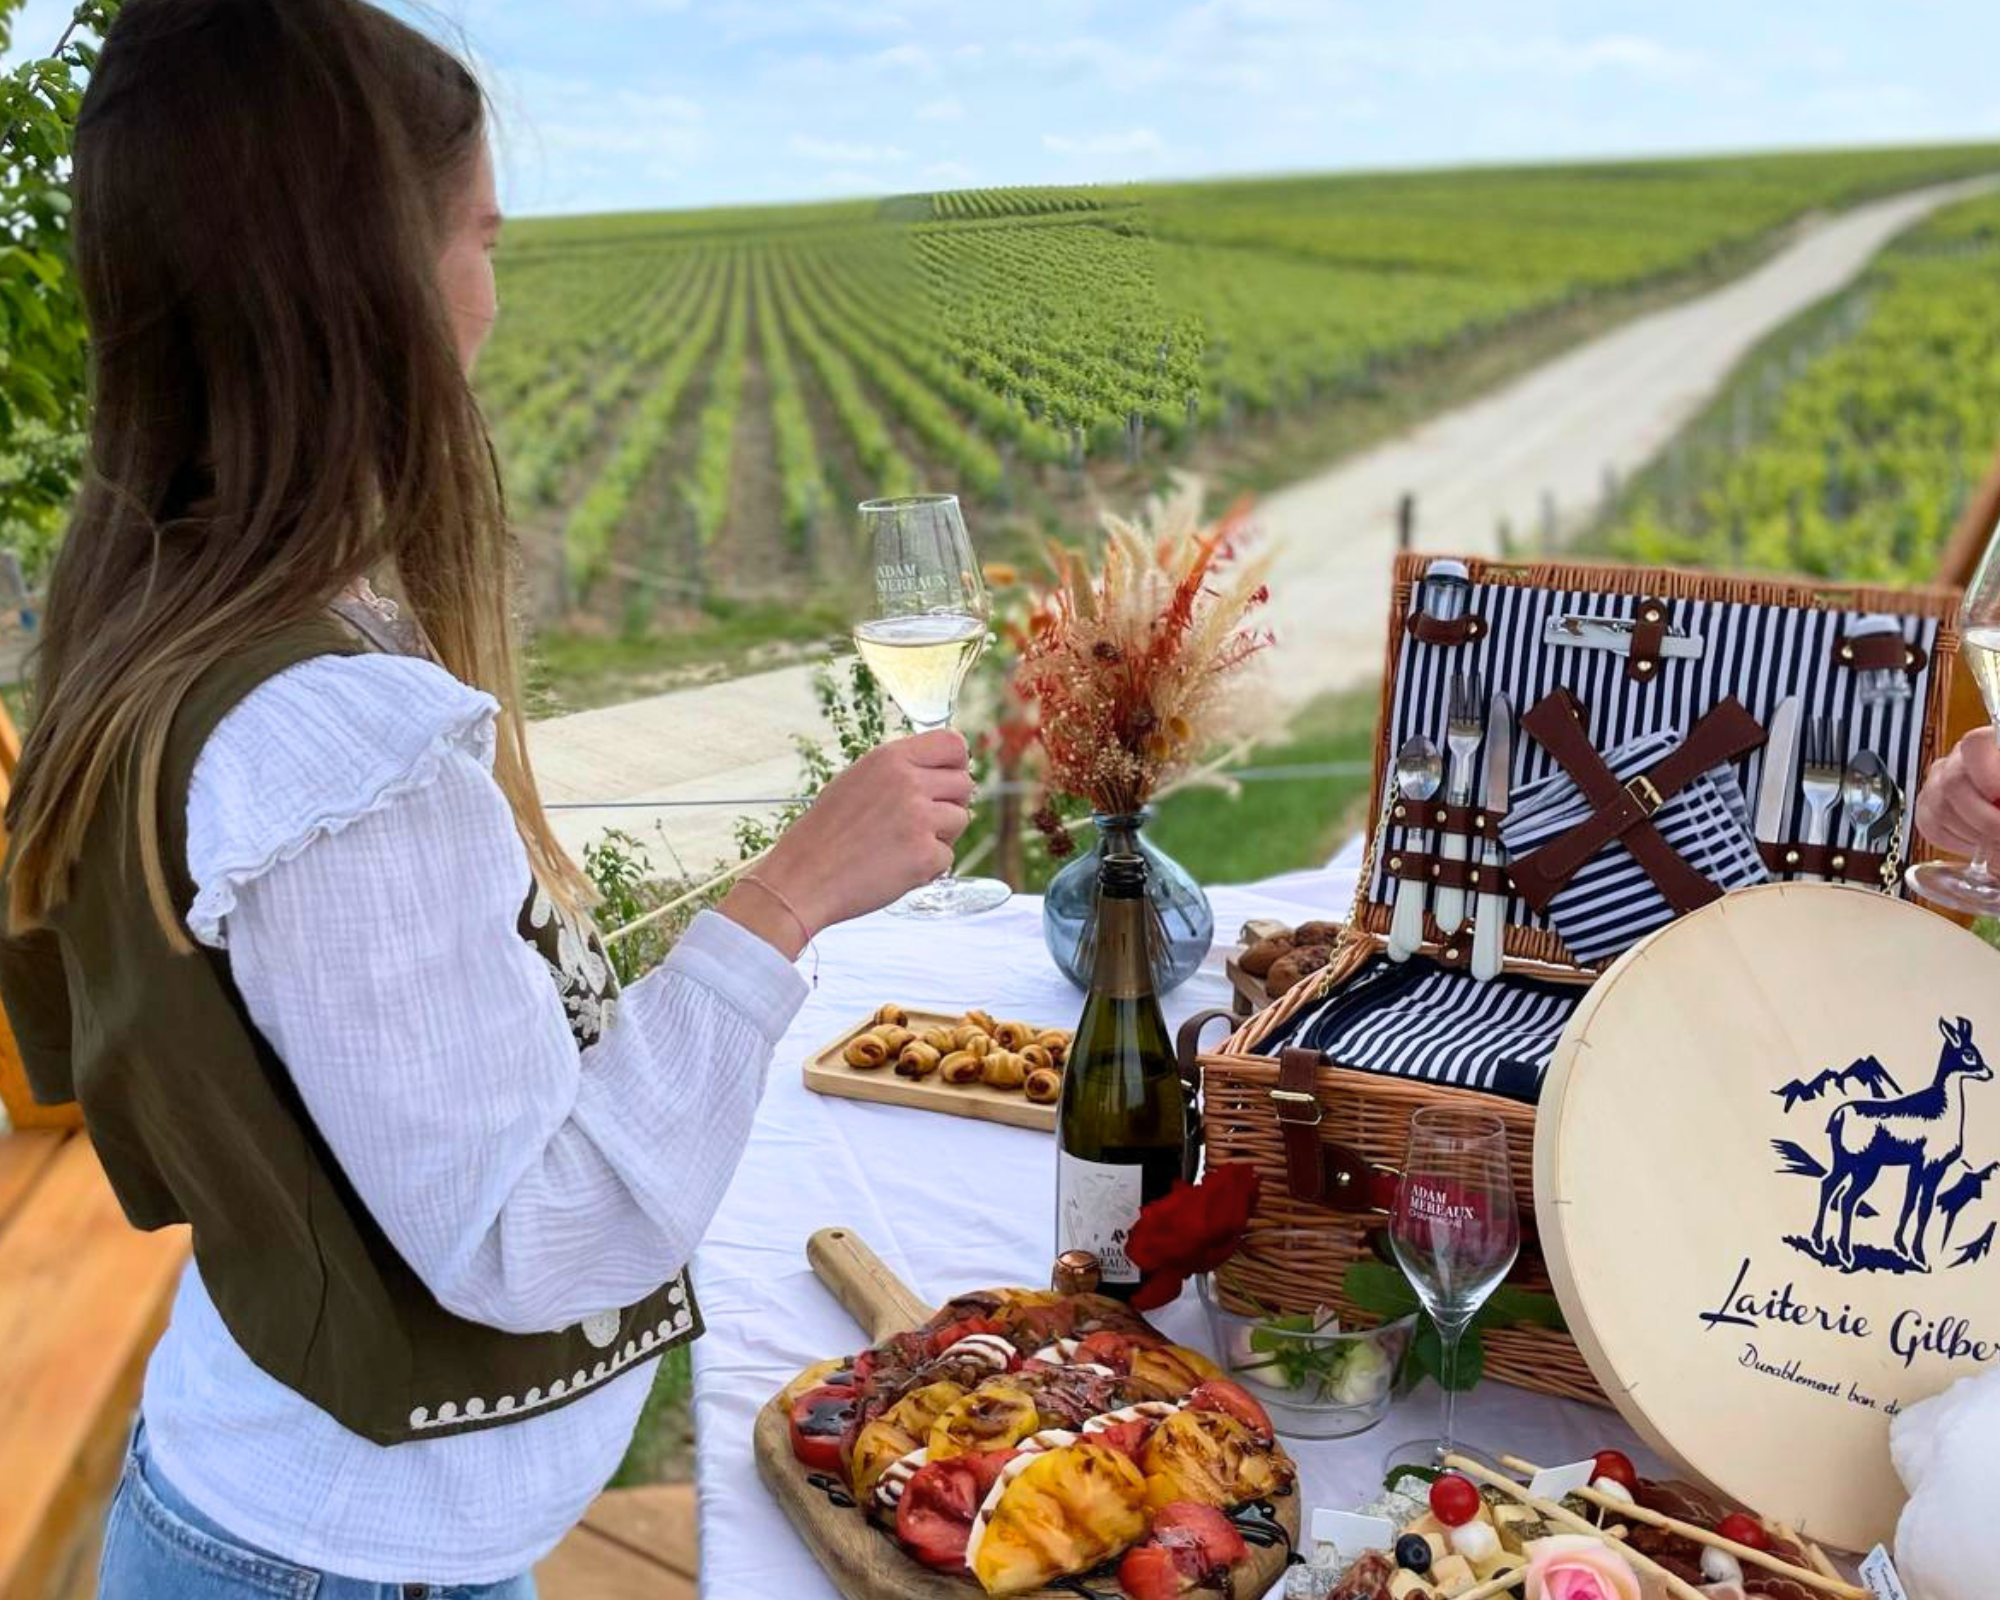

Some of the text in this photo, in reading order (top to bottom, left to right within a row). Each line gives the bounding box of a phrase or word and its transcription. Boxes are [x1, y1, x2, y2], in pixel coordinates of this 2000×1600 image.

[877, 564, 916, 577] ADAM
[877, 575, 947, 591] MEREAUX
[1411, 1184, 1447, 1204] ADAM
[1410, 1196, 1475, 1220] MEREAUX
[1099, 1247, 1122, 1258] ADA
[1699, 1257, 1872, 1338] Laiterie
[1738, 1343, 1840, 1397] Durablement
[1847, 1382, 1876, 1409] bon
